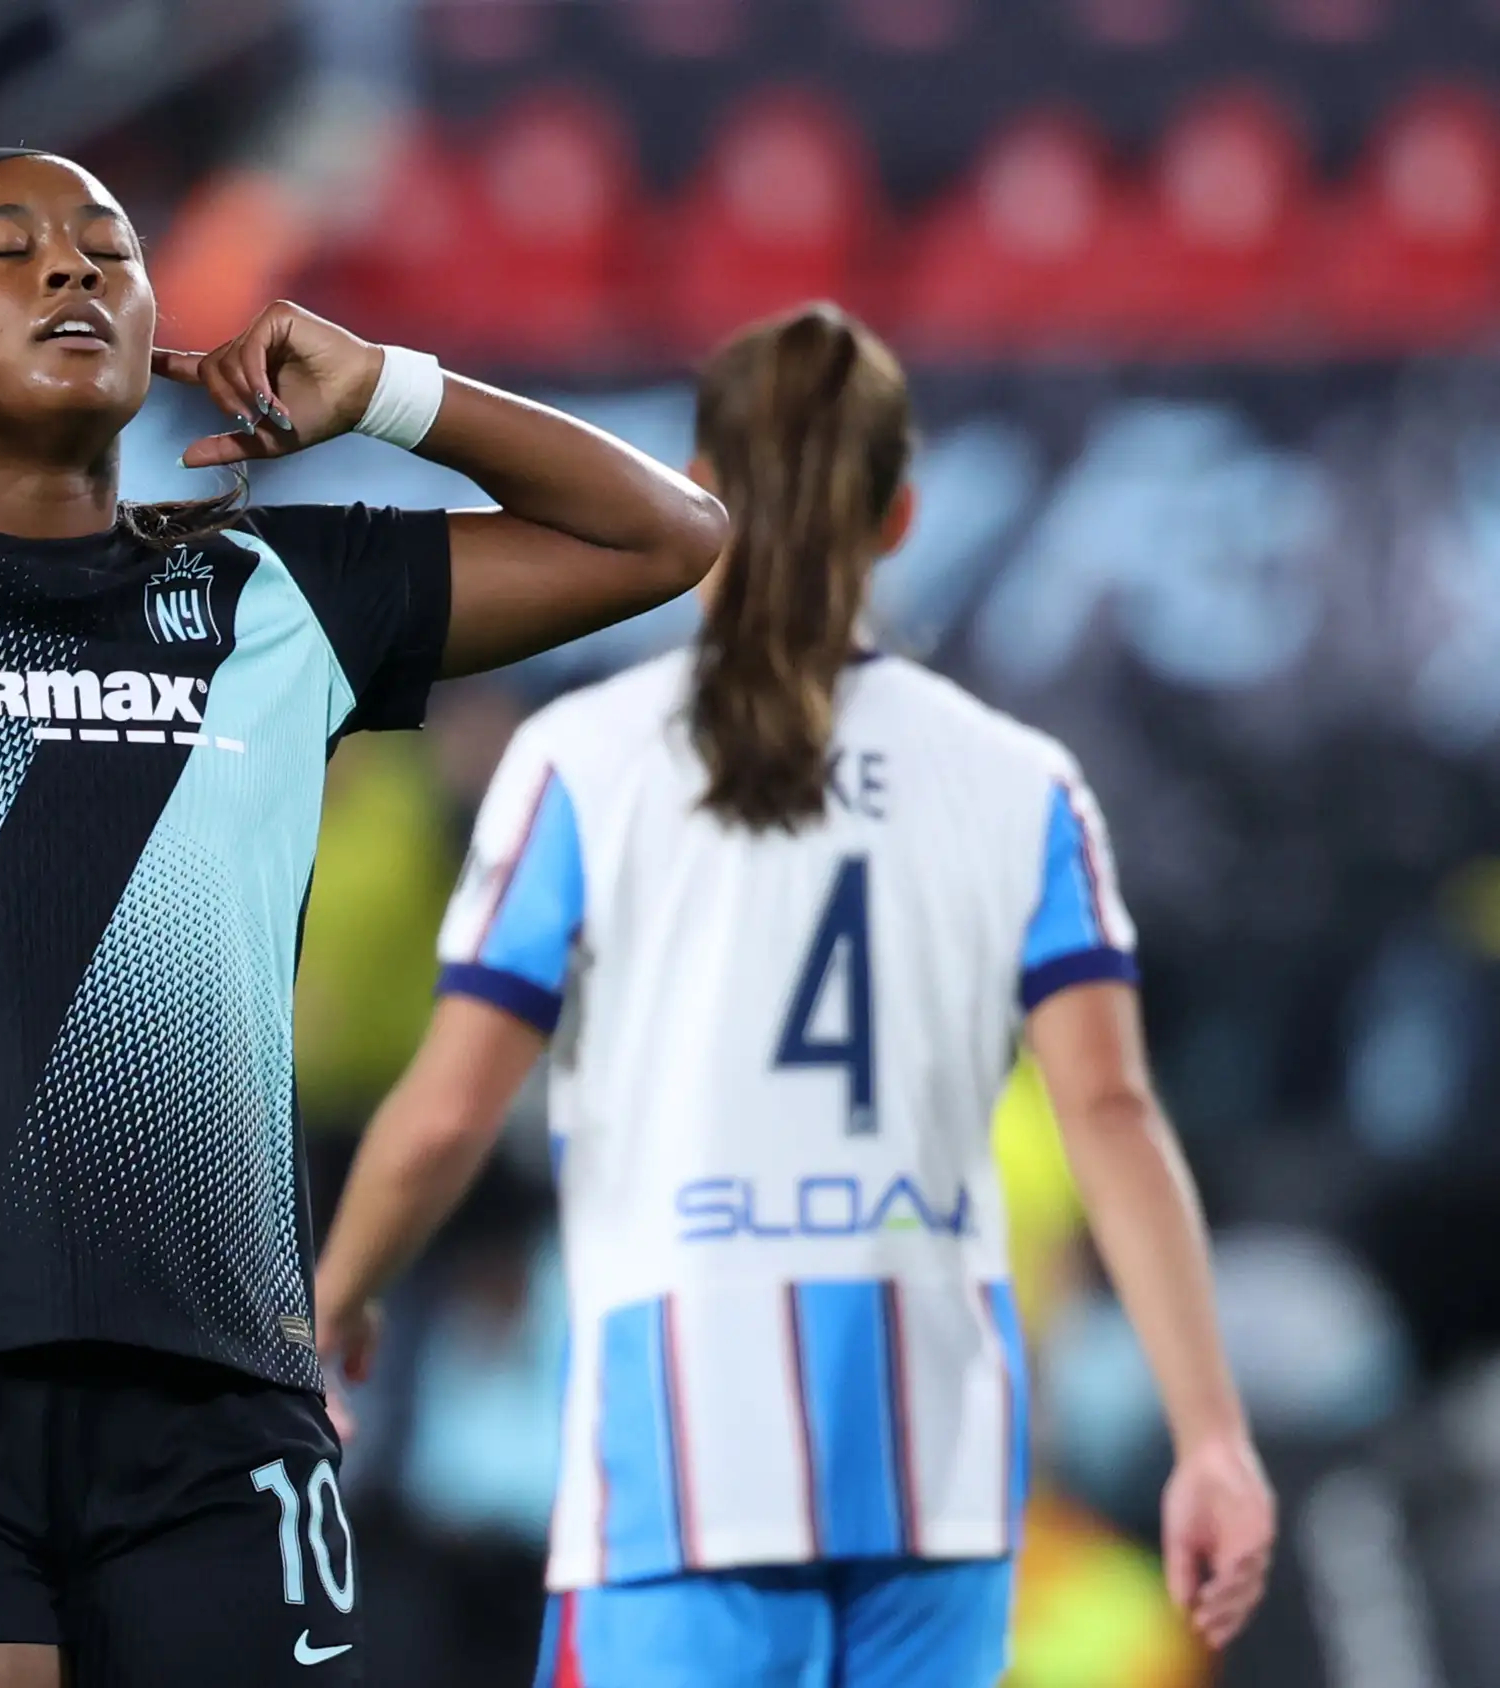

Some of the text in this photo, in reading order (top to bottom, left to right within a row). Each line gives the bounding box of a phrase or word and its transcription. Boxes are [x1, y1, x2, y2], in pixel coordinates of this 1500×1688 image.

[156, 589, 208, 642] NY
[771, 852, 879, 1134] 4
[250, 1458, 355, 1613] 10
